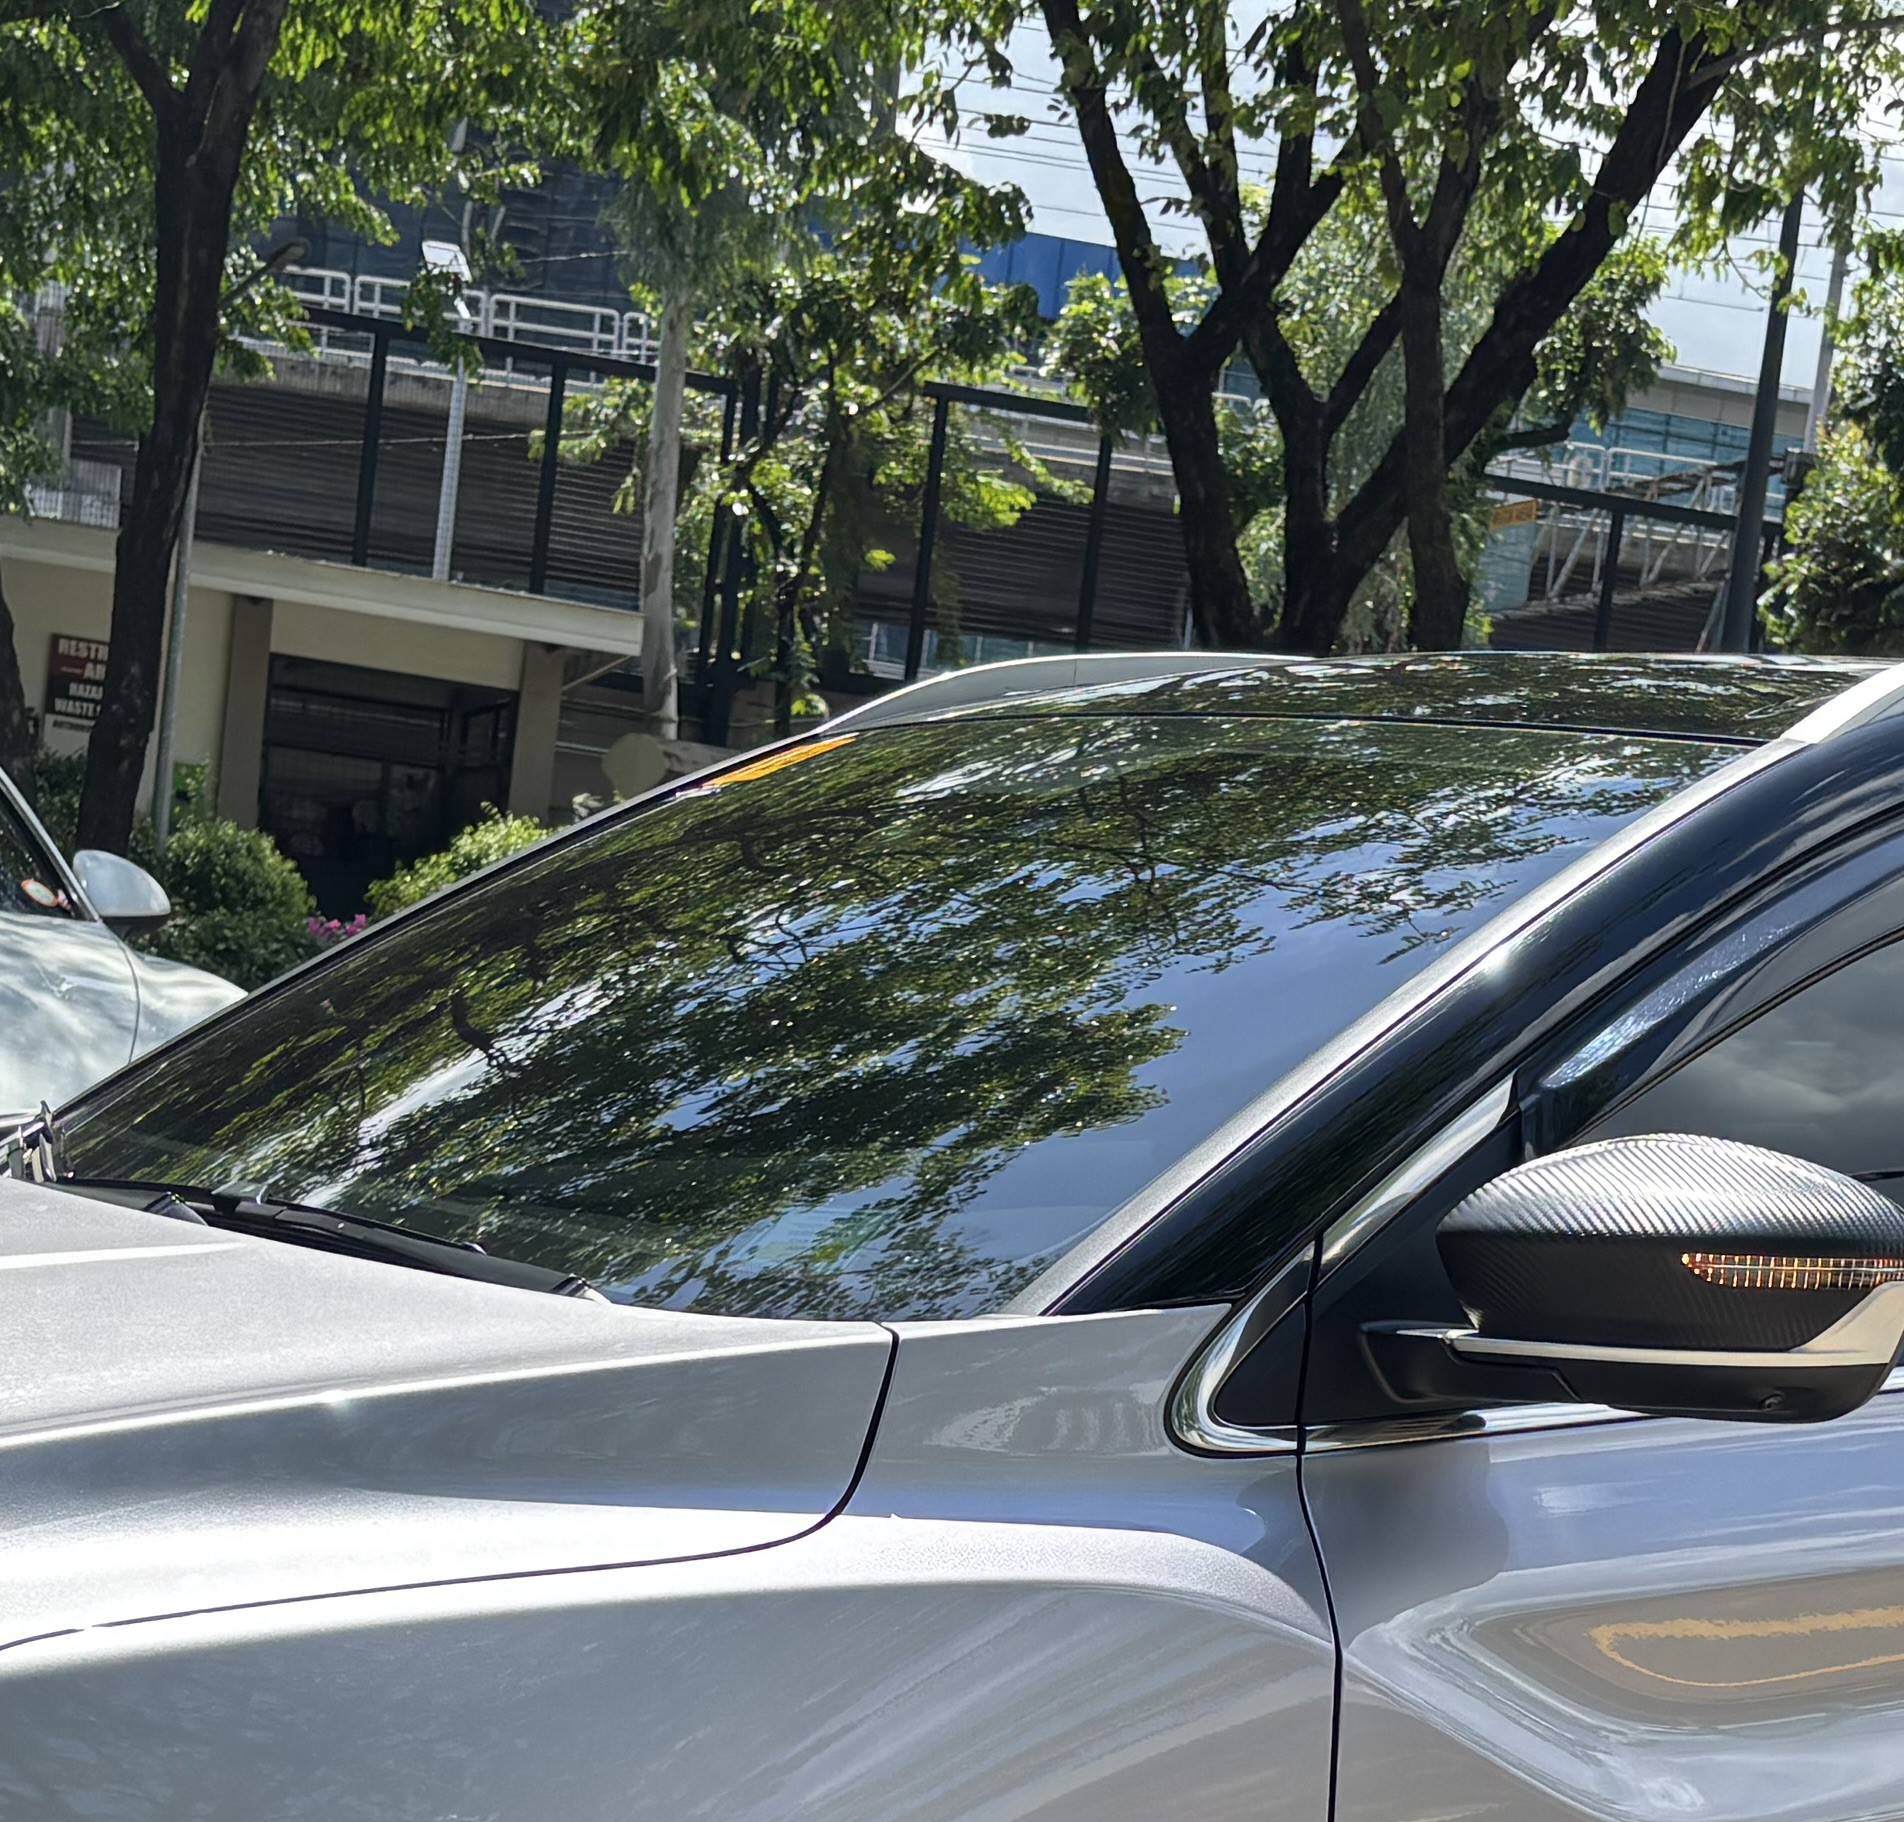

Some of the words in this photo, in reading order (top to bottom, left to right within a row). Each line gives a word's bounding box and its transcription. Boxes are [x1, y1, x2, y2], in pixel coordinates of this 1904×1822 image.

[58, 638, 109, 662] RESTR
[83, 661, 107, 680] AR
[69, 682, 104, 700] HAZA
